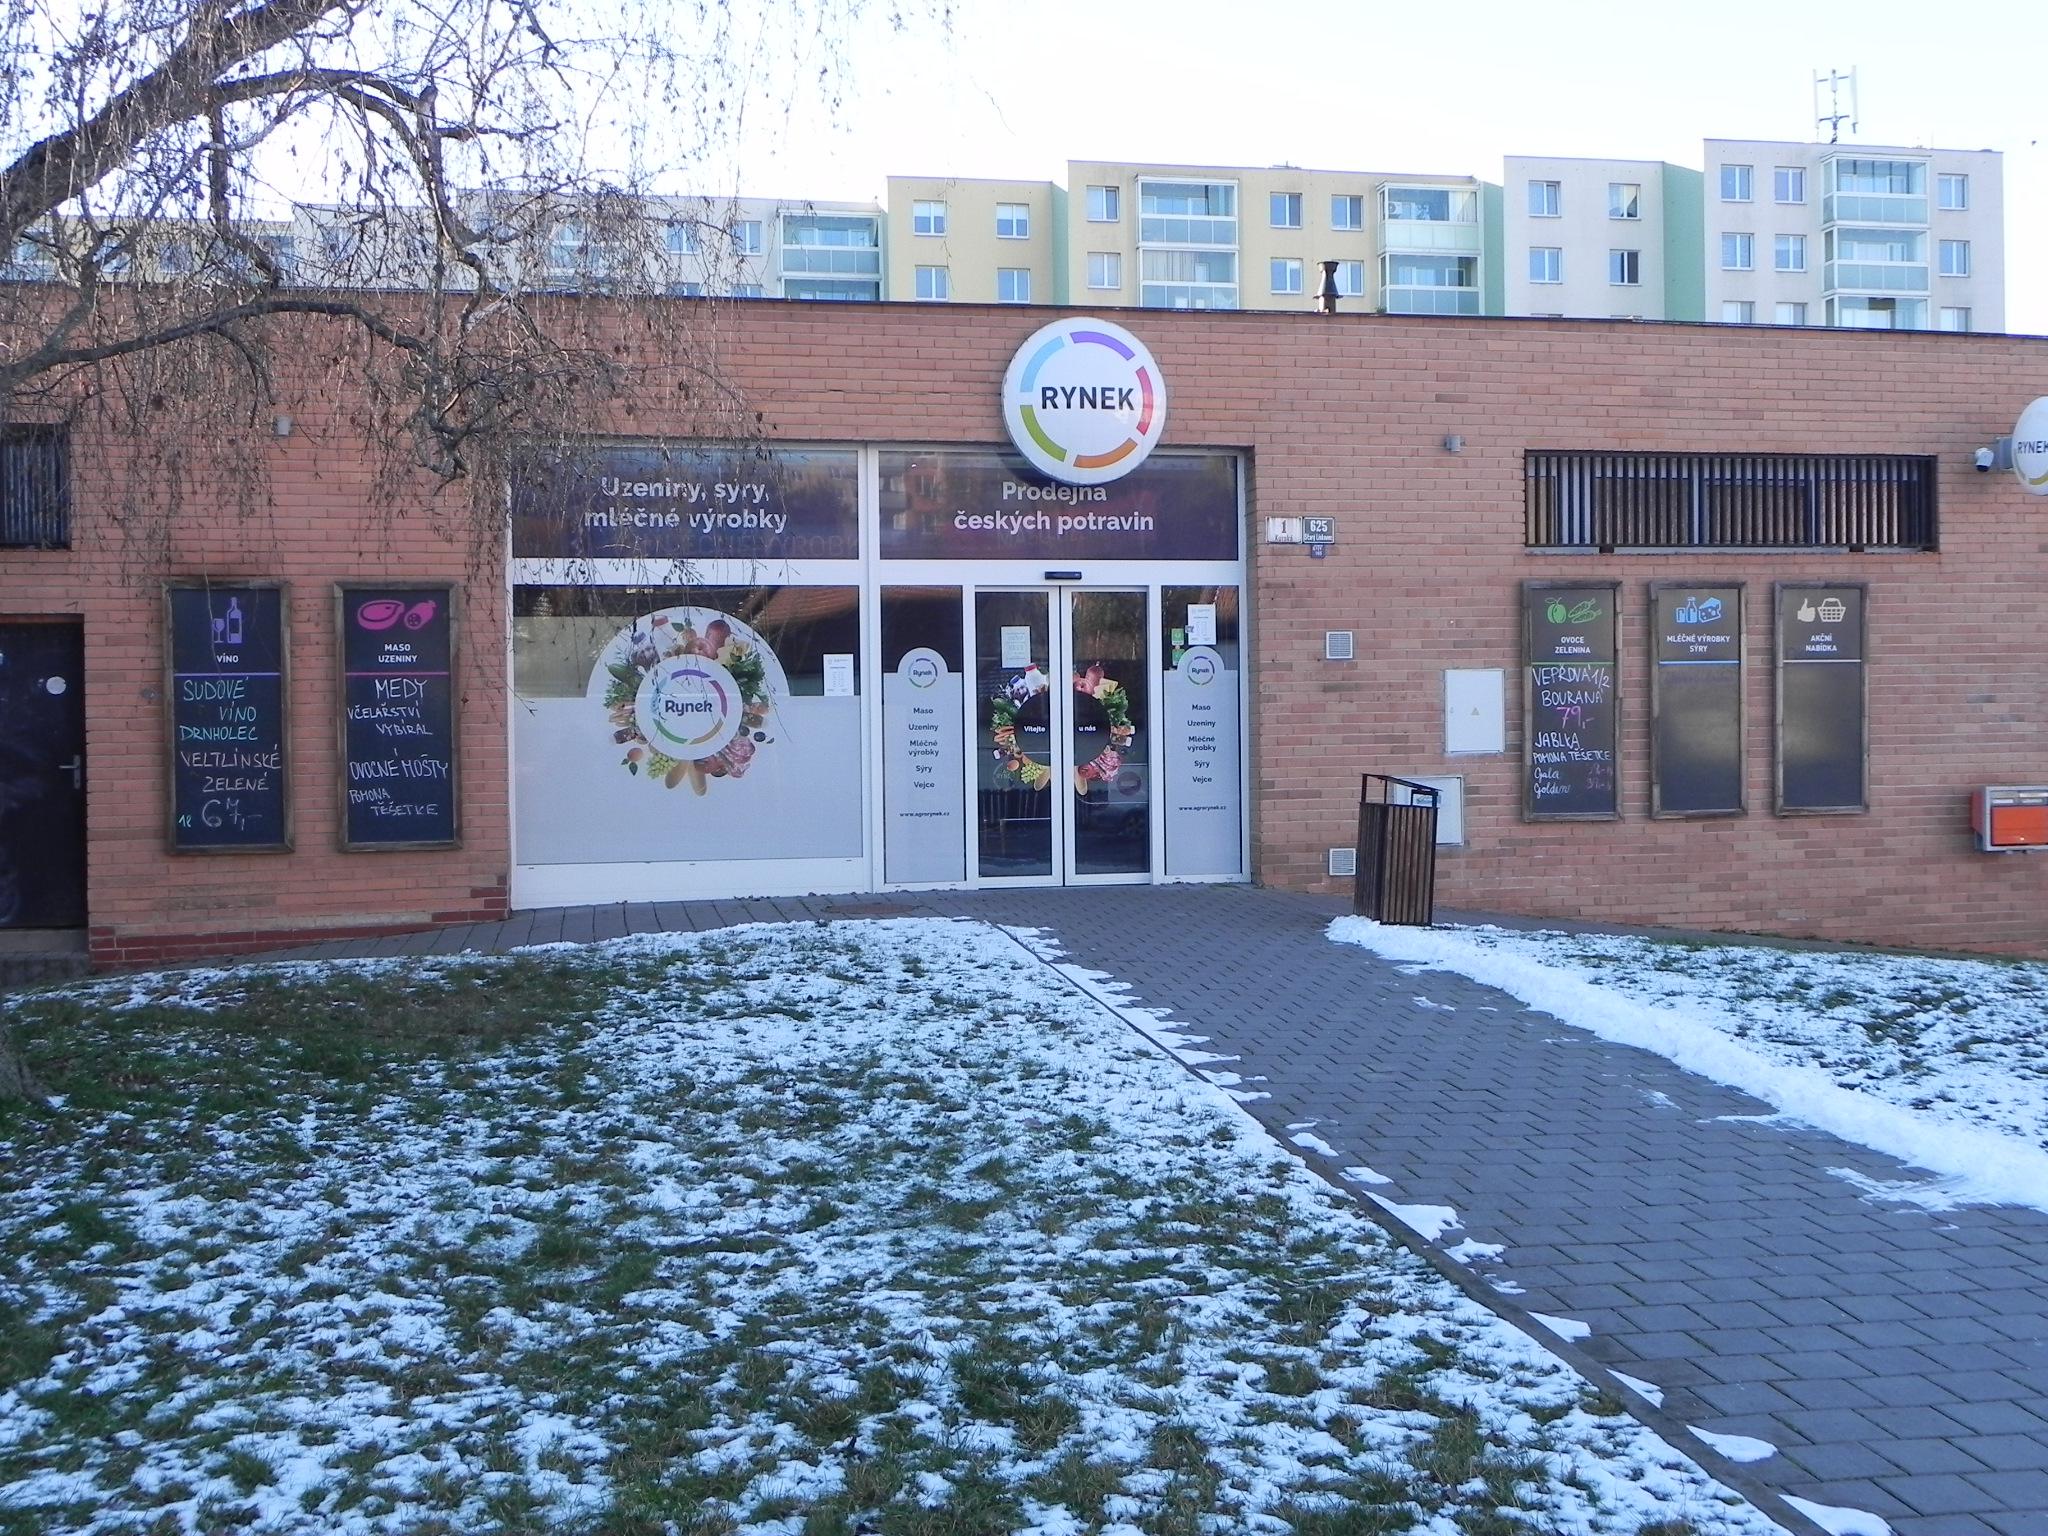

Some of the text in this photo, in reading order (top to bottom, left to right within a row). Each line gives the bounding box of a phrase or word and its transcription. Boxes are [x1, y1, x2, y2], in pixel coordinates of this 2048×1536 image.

[1041, 386, 1135, 411] RYNEK
[600, 476, 707, 503] Uzeniny,
[1002, 481, 1108, 506] Prodejna
[584, 507, 787, 534] mléčné výrobky
[954, 510, 1154, 536] českých potravin
[1282, 520, 1287, 533] 1
[1310, 520, 1328, 532] 625
[1560, 636, 1585, 644] OVOCE
[1666, 632, 1731, 643] MLÉČNÉ VÝROBKY
[1811, 632, 1833, 642] AKČNÍ
[384, 643, 411, 652] MASO
[1554, 646, 1591, 654] ZELENINA
[1689, 643, 1708, 653] SÝRY
[1805, 642, 1838, 652] NABÍDKA
[216, 653, 239, 663] VÍNO
[378, 654, 418, 663] UZENINY
[913, 669, 932, 677] Rynek
[1191, 667, 1210, 675] Rynek
[183, 676, 250, 702] SUDOVÉ
[374, 678, 428, 700] MEDY
[219, 701, 257, 722] VÍNO
[664, 699, 713, 717] Rynek
[908, 723, 939, 732] Uzeniny
[1084, 724, 1097, 732] nás
[1187, 720, 1216, 728] Uzeniny
[179, 725, 258, 742] DRNHOLEC
[909, 739, 938, 747] Mléčné
[1188, 735, 1215, 743] Mléčné
[1534, 731, 1581, 749] JABLKA
[908, 749, 939, 757] výrobky
[1187, 744, 1217, 753] výrobky
[180, 744, 282, 769] VELTLÍNSKÉ
[915, 764, 933, 774] Sýry
[1194, 760, 1211, 769] Sýry
[202, 772, 269, 793] ZELENÉ
[913, 781, 935, 789] Vejce
[1192, 776, 1212, 784] Vejce
